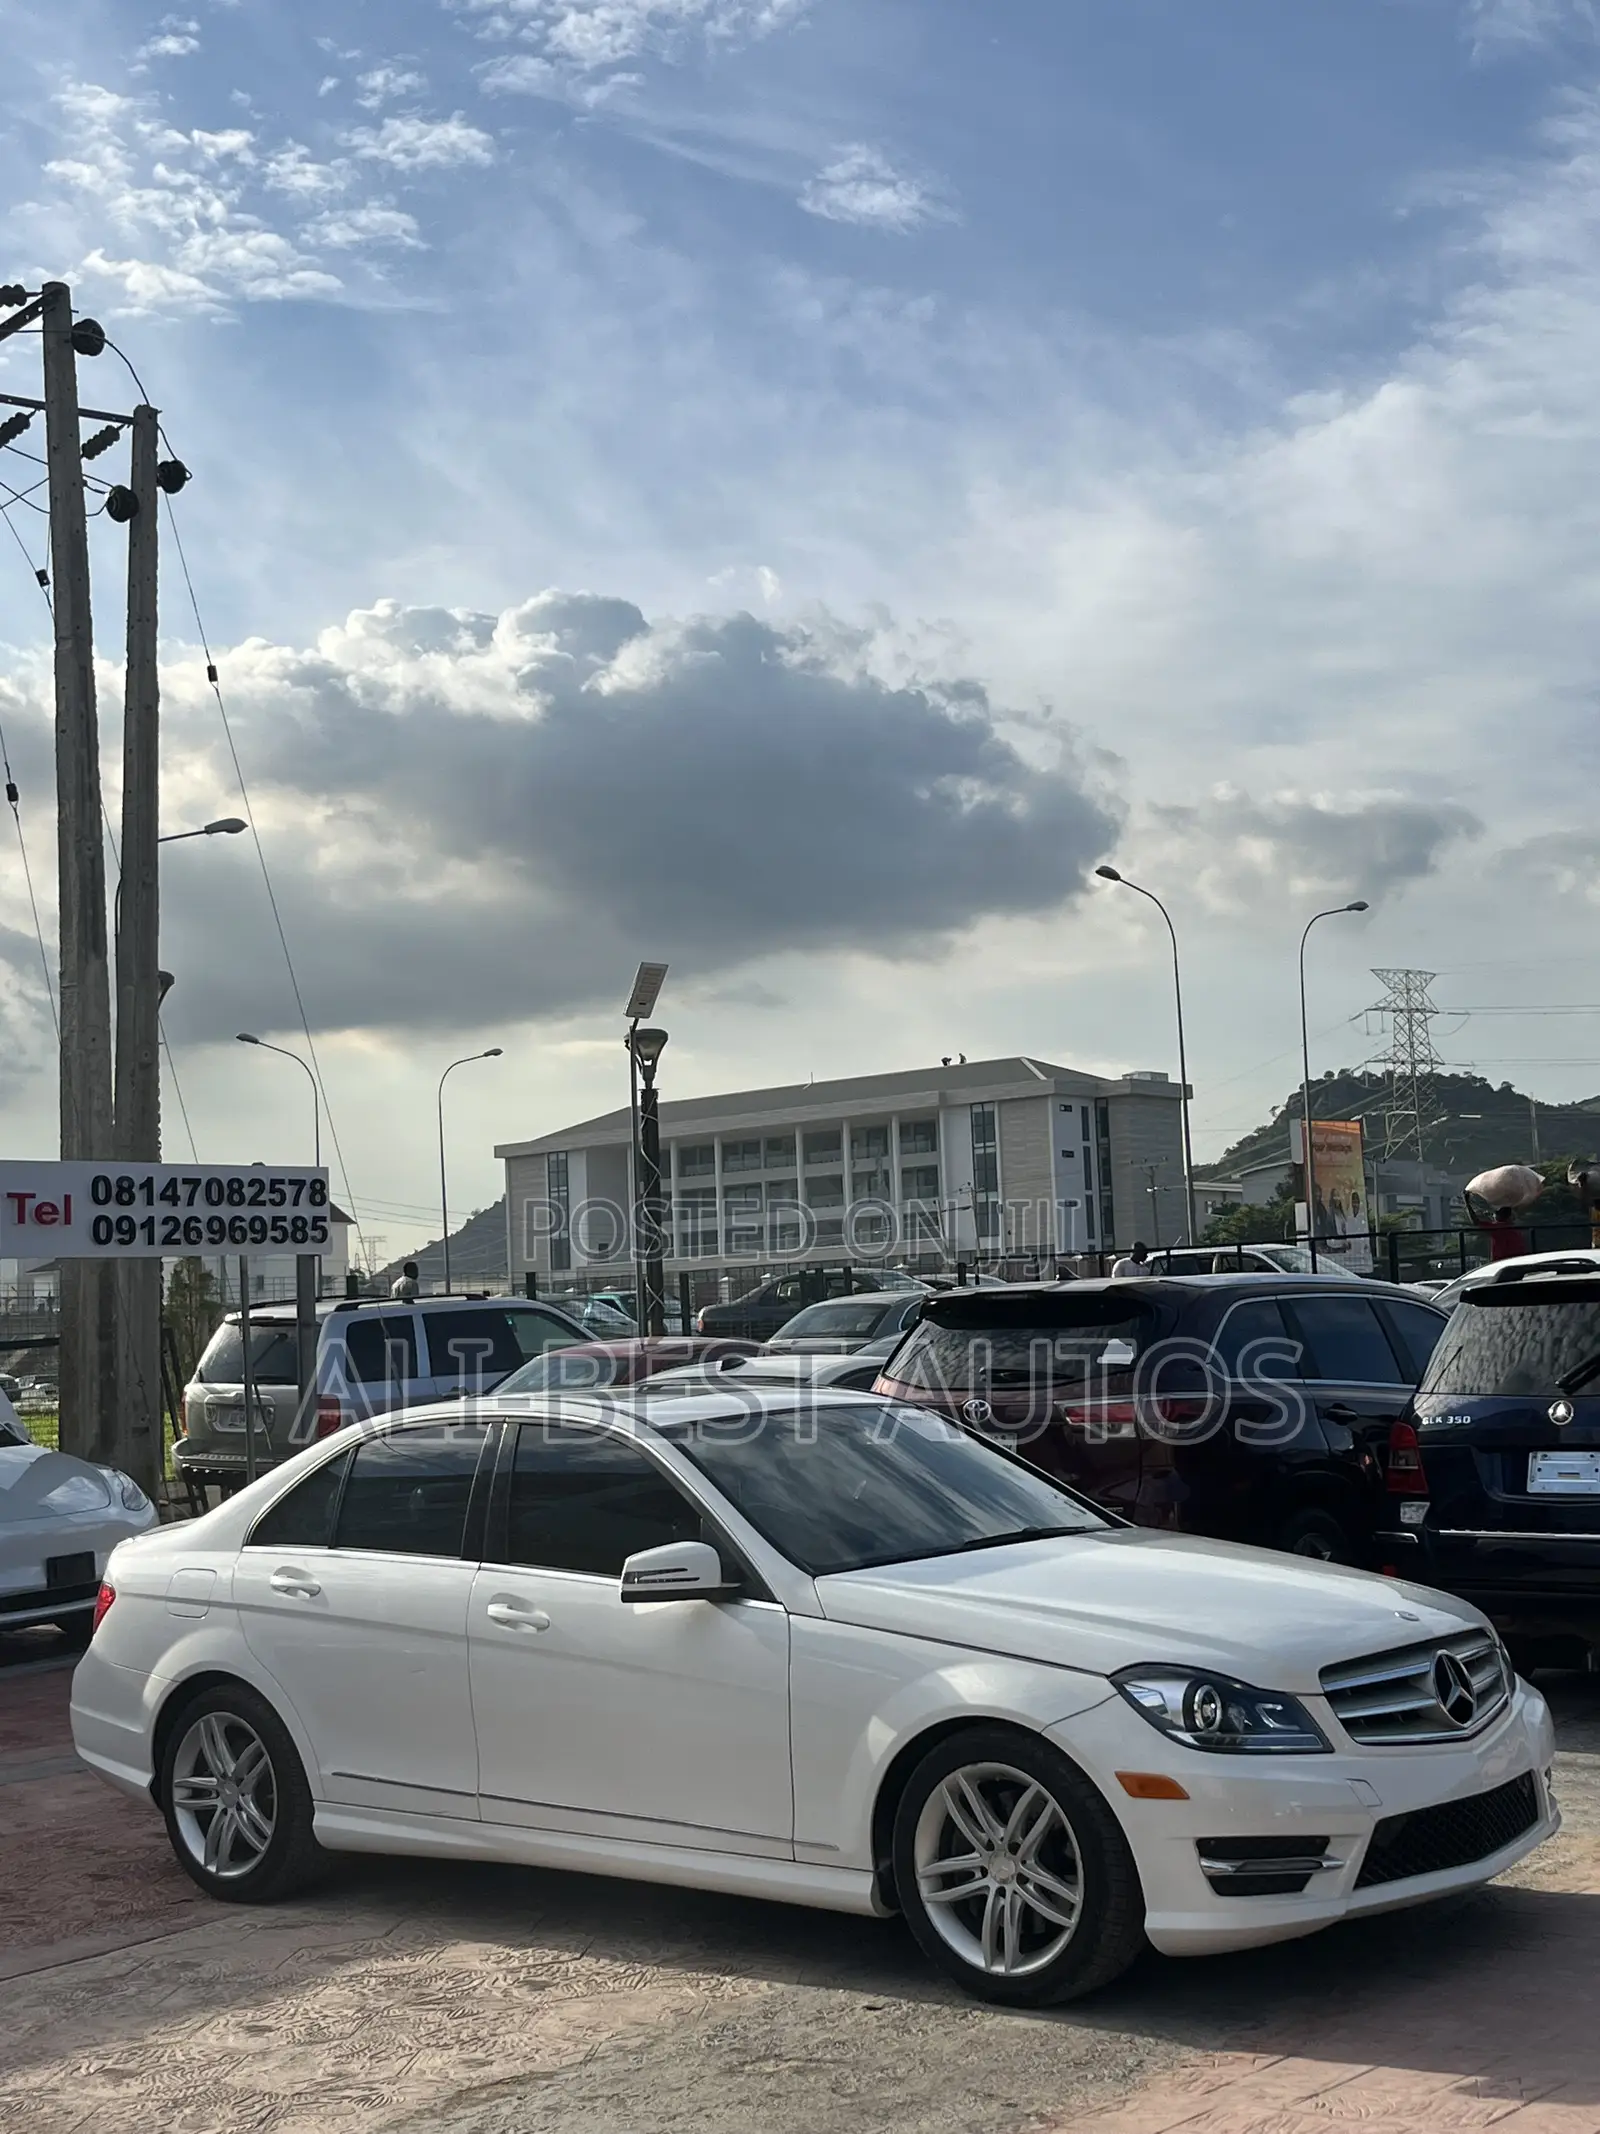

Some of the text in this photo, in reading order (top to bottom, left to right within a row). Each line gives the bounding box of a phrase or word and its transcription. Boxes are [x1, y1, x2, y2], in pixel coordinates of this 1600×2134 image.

[90, 1174, 327, 1207] 08147082578
[6, 1191, 72, 1226] Tel
[91, 1214, 329, 1246] 09126969585
[1421, 1414, 1472, 1426] GLK 350
